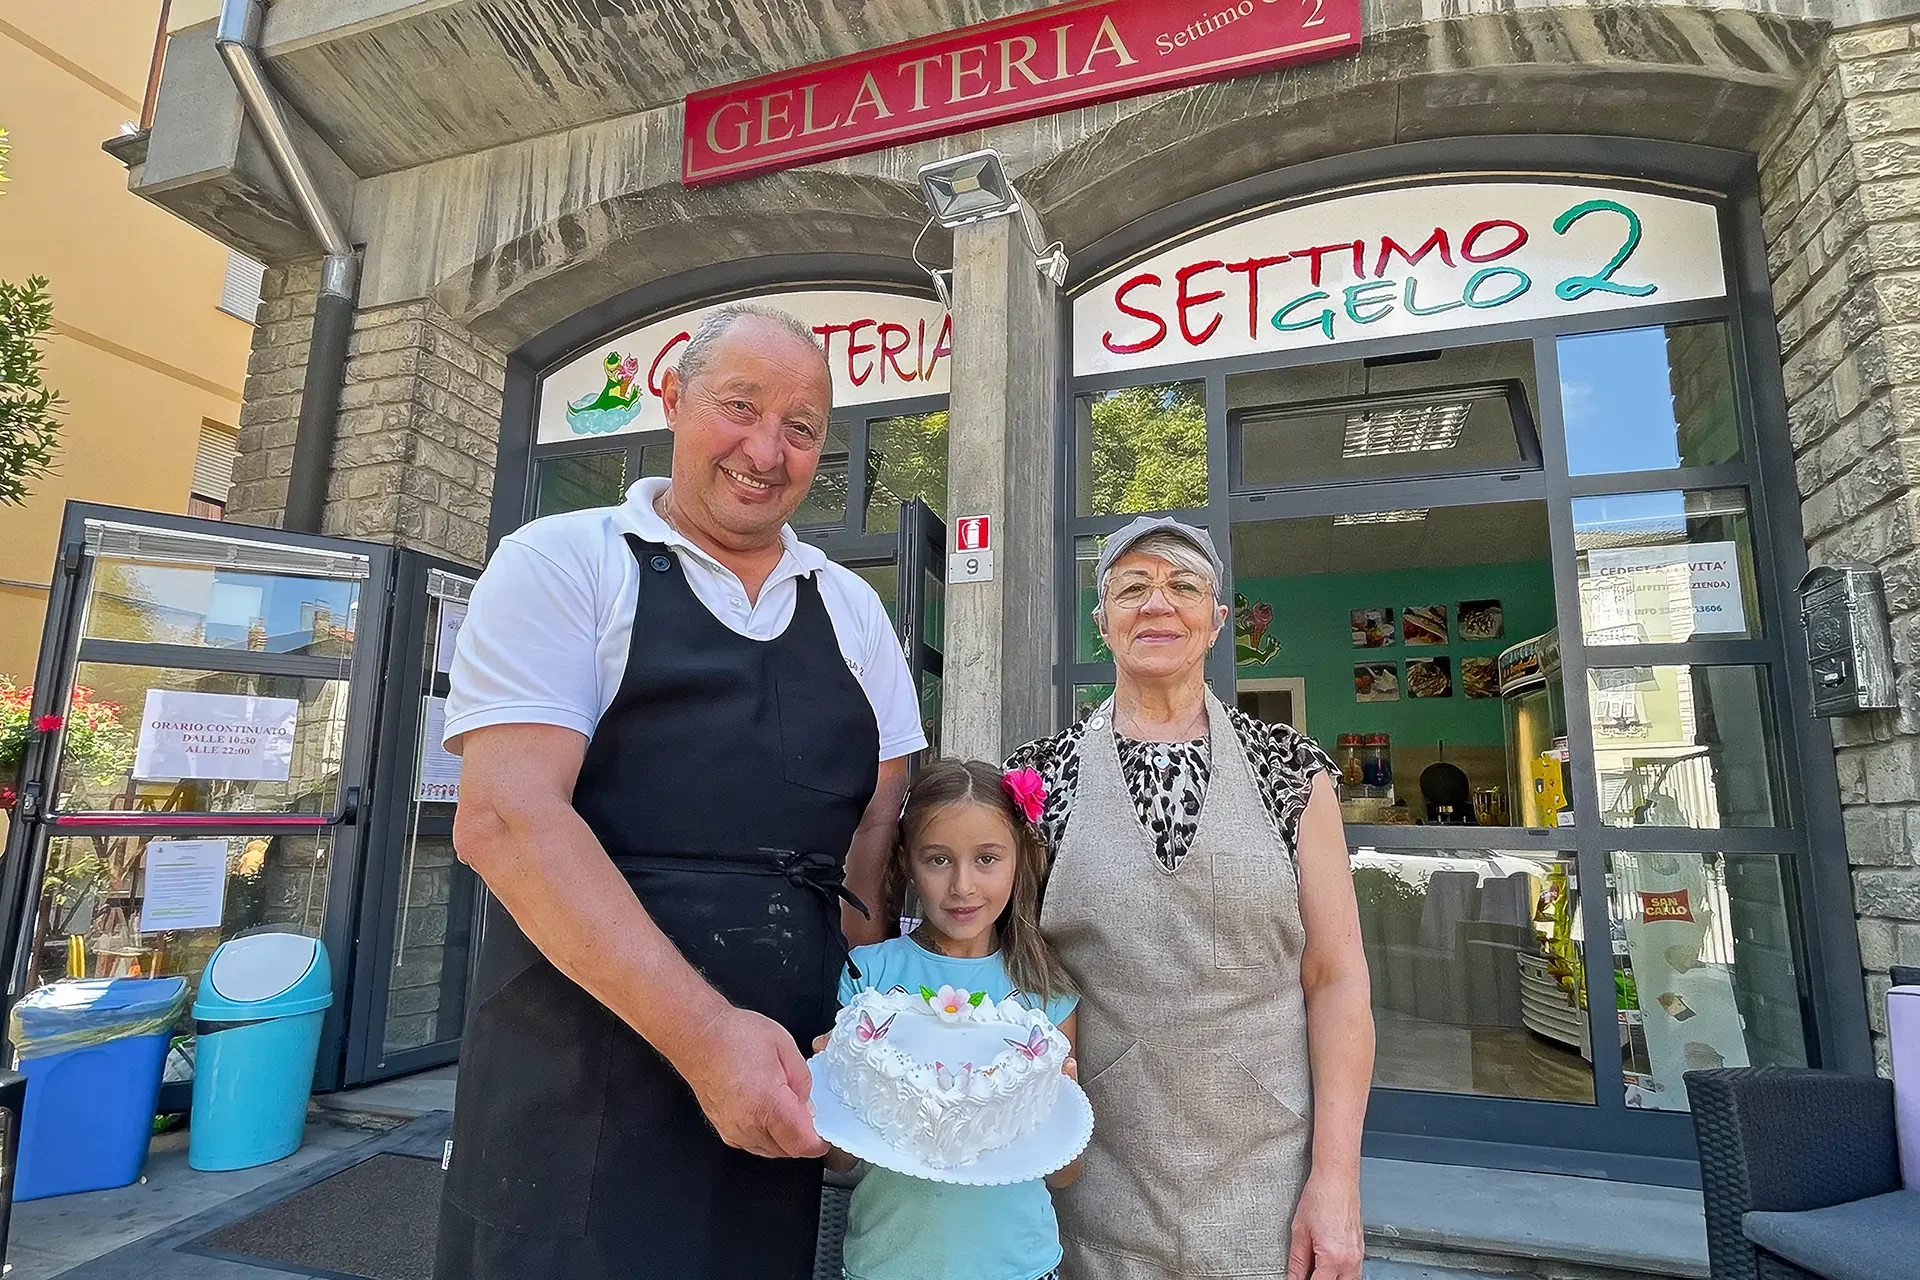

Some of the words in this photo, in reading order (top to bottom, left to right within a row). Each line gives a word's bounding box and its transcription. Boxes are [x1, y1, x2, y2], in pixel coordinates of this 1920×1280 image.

[1301, 0, 1326, 28] 2
[705, 14, 1139, 155] GELATERIA
[1155, 0, 1254, 56] Settimo
[1271, 266, 1533, 340] GELO
[1552, 199, 1657, 301] 2
[1102, 218, 1529, 354] SETTIMO
[966, 558, 979, 575] 9
[151, 721, 204, 732] ORARIO
[206, 724, 287, 736] CONTINUATO
[182, 734, 225, 744] DALLE
[228, 736, 256, 745] 10:30
[185, 745, 219, 754] ALLE
[222, 747, 251, 755] 22:00
[1650, 897, 1679, 907] SAN
